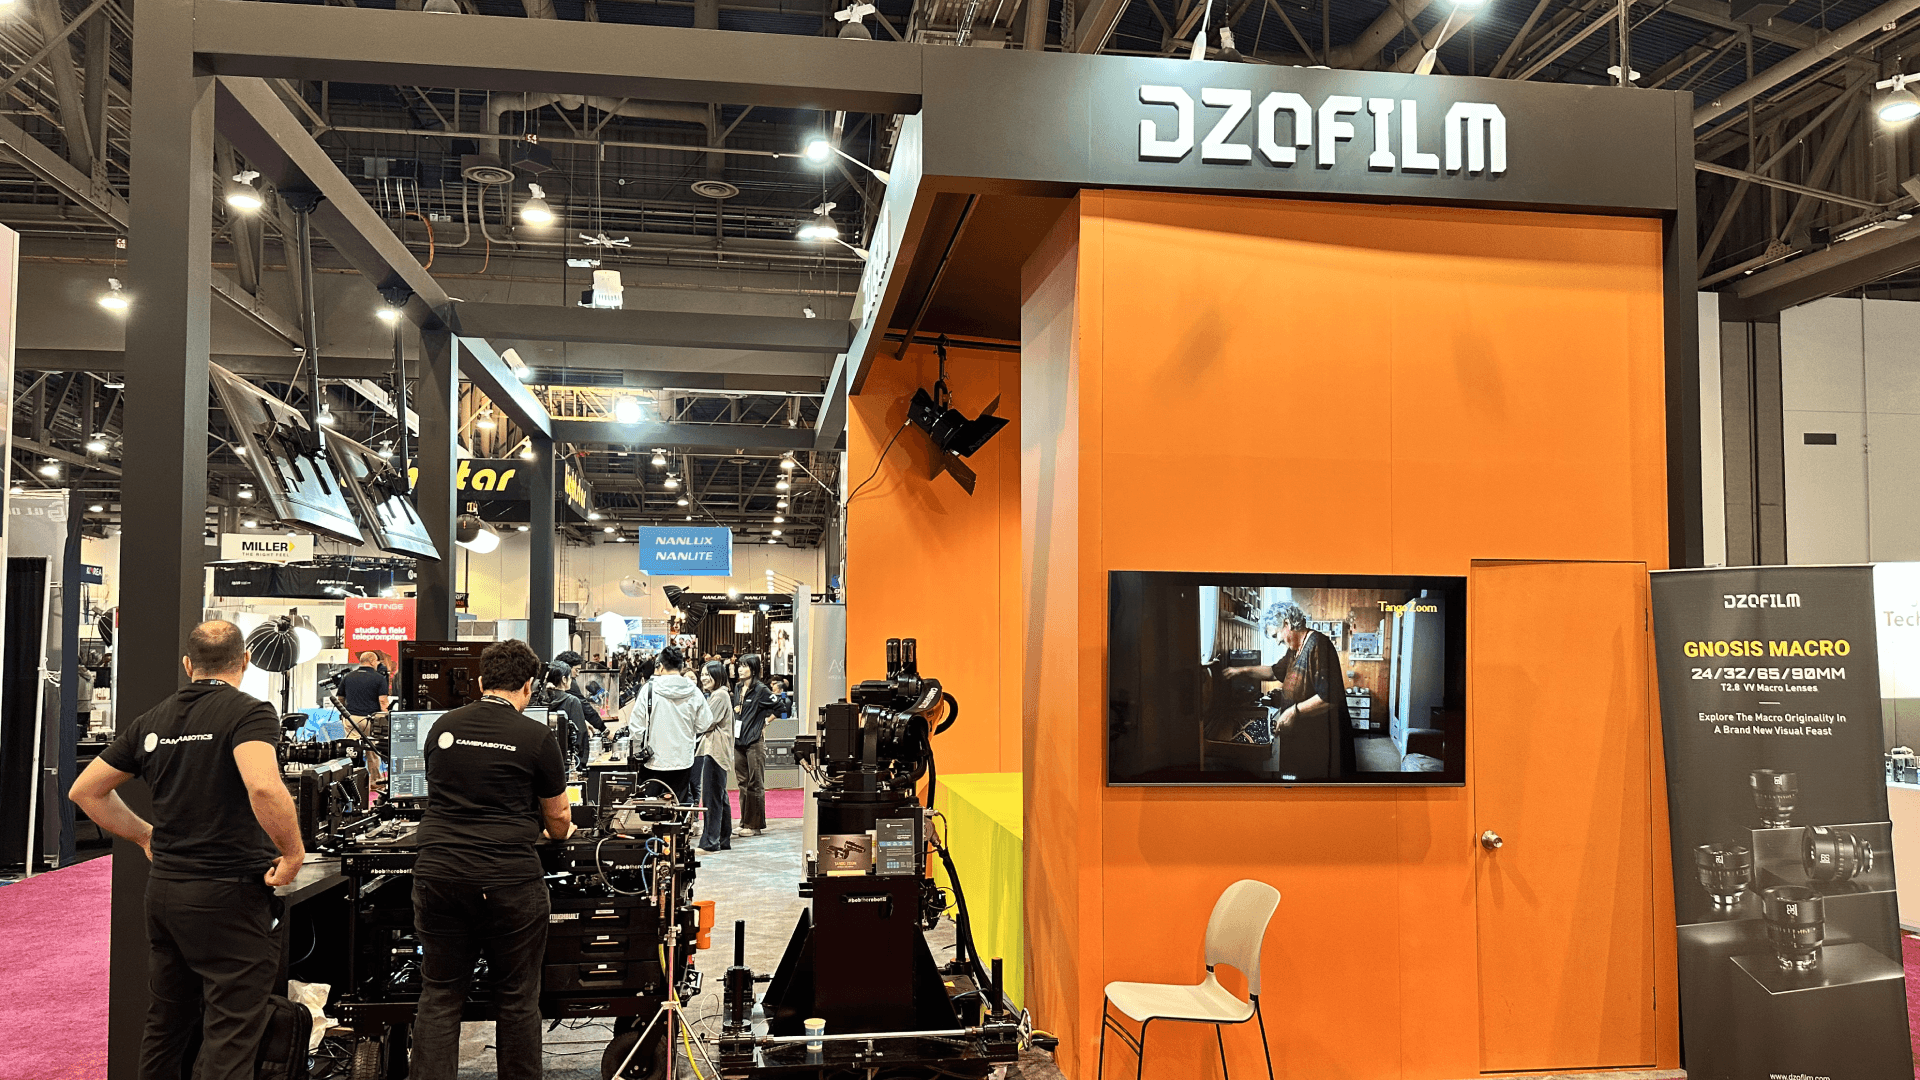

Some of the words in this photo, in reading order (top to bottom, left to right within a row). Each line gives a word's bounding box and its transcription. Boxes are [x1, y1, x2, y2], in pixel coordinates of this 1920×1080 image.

[1882, 22, 1897, 31] 638
[1138, 84, 1507, 173] DZOFILM
[242, 541, 288, 552] MILLER
[655, 536, 713, 546] NANLUX
[655, 551, 714, 561] NANLITE
[357, 602, 404, 611] FORTINGE
[1723, 593, 1801, 609] DZOFILM
[1377, 600, 1408, 618] Tango
[1409, 600, 1438, 613] Zoom
[354, 626, 380, 634] studio
[380, 626, 387, 634] &
[388, 626, 406, 634] field
[352, 633, 408, 642] teleprompters
[1683, 640, 1764, 658] GNOSIS
[1768, 639, 1851, 658] MACRO
[1691, 667, 1846, 680] 24/32/65/90MM
[1720, 683, 1741, 692] T2.8
[1756, 683, 1784, 693] Macro
[1785, 684, 1819, 693] Lenses
[1698, 712, 1735, 723] Explore
[1736, 712, 1754, 722] The
[1755, 713, 1783, 723] Macro
[1784, 713, 1835, 725] Originality
[1836, 714, 1847, 723] In
[1713, 725, 1722, 734] A
[1723, 725, 1751, 735] Brand
[1752, 726, 1773, 735] New
[1774, 726, 1804, 736] Visual
[1805, 727, 1833, 736] Feast
[160, 733, 213, 744] CAMABOTICS
[456, 739, 517, 752] CAMERABOTICS
